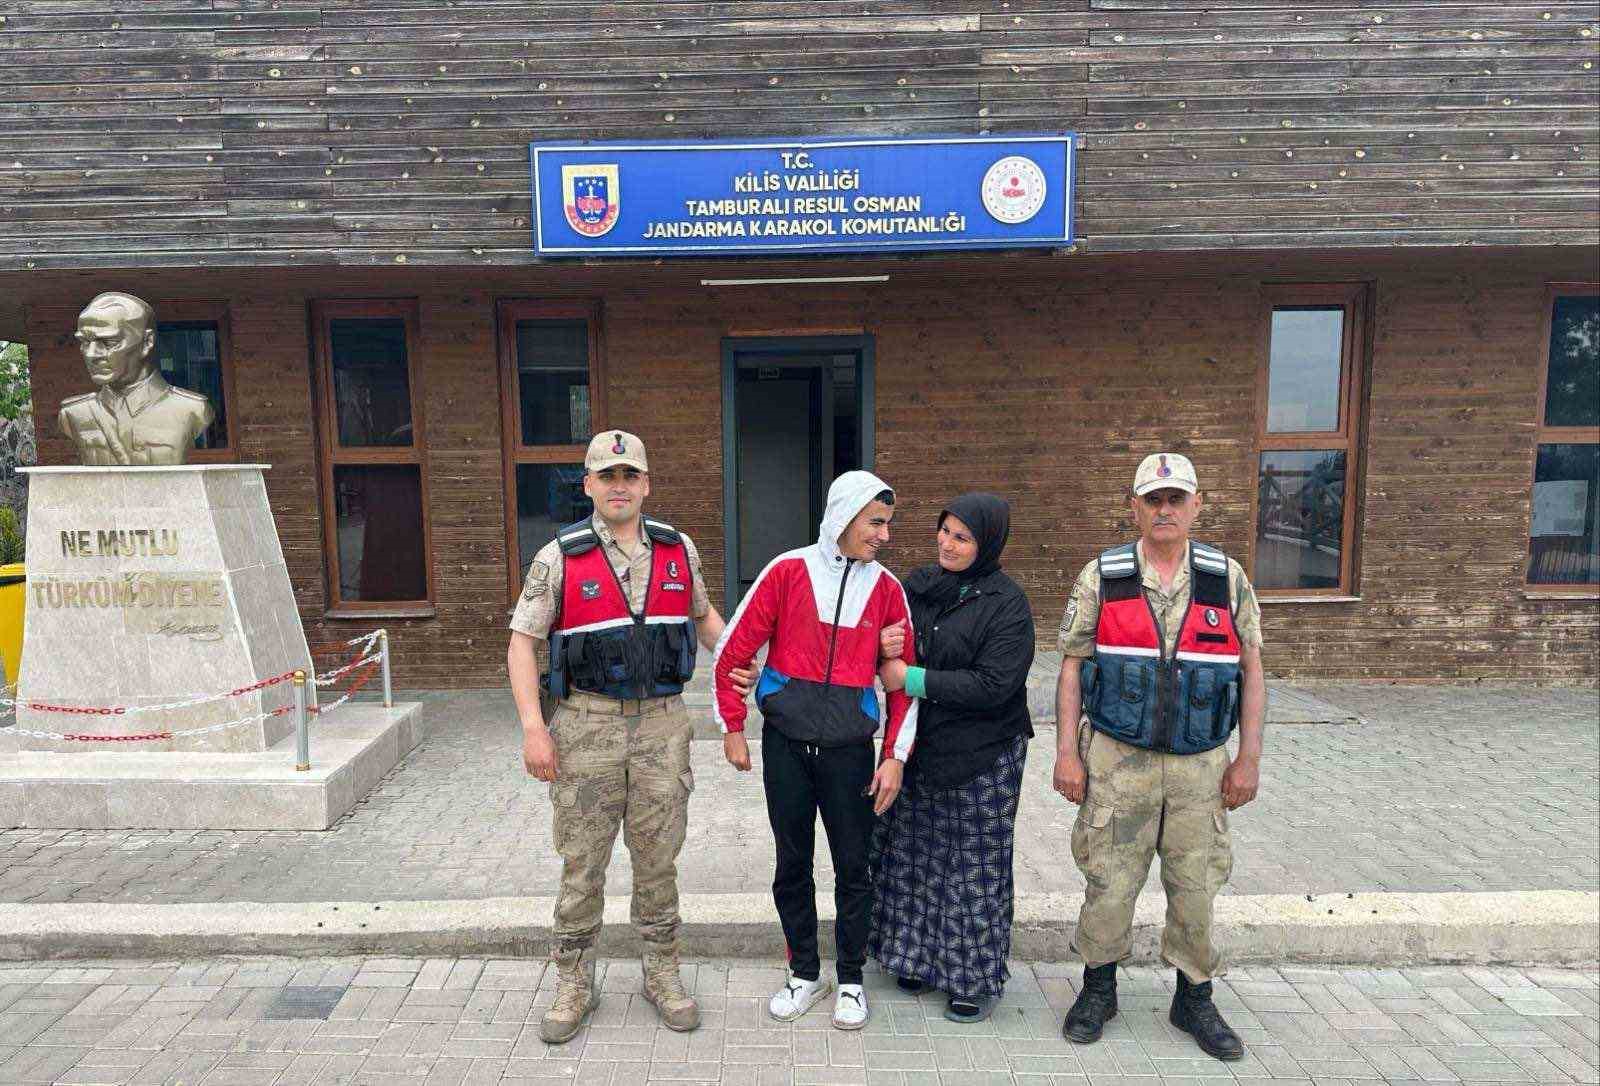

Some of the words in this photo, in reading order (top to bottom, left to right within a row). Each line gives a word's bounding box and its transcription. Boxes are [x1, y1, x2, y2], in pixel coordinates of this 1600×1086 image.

[781, 152, 814, 169] T.C.
[734, 170, 781, 192] KİLİS
[784, 169, 860, 191] VALİLİĞİ
[686, 199, 790, 216] TAMBURALI
[794, 196, 849, 214] RESUL
[853, 196, 921, 213] OSMAN
[642, 220, 747, 238] JANDARMA
[750, 218, 836, 236] KARAKOL
[841, 212, 966, 235] KOMUTANLIĞI
[60, 530, 91, 556] NE
[97, 529, 178, 557] MUTLU
[31, 575, 135, 608] TÜRKÜM
